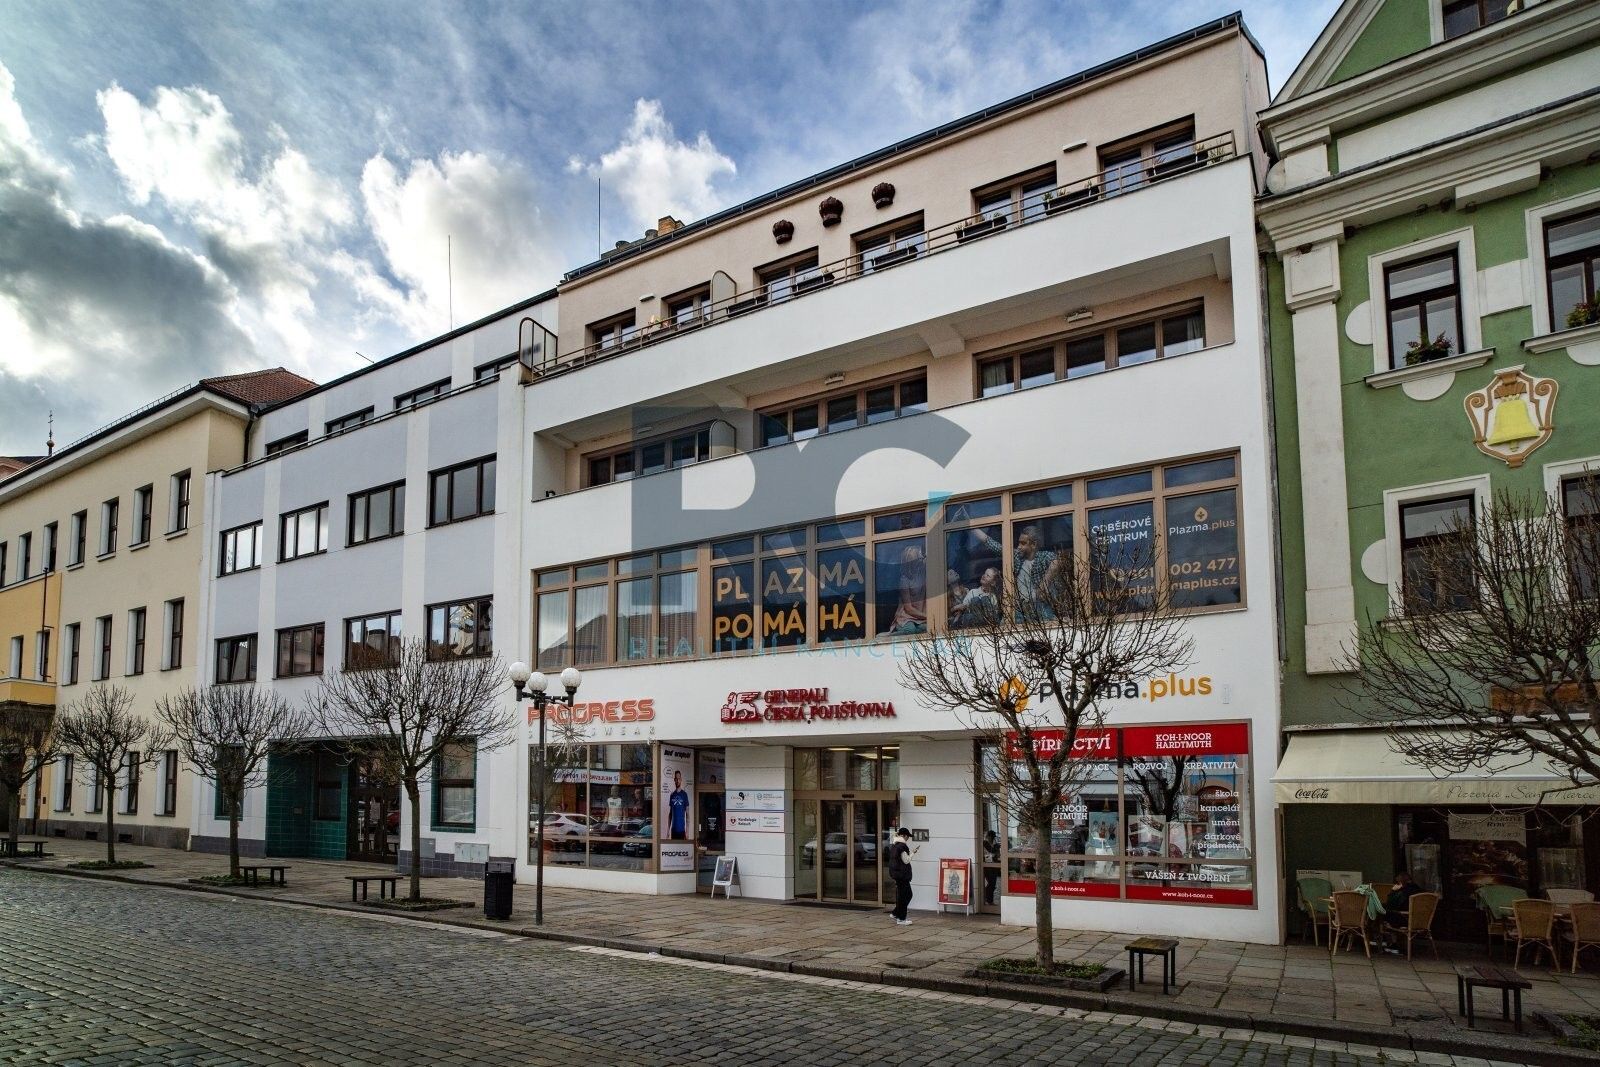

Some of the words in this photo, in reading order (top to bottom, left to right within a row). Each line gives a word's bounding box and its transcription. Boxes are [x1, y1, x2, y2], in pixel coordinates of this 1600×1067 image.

[1169, 518, 1236, 536] Plazma.plus
[1170, 561, 1202, 576] 002
[1206, 557, 1237, 572] 477
[1039, 672, 1213, 703] Pama.plus
[764, 687, 830, 704] GENERALI
[527, 698, 656, 727] PROGRESS
[764, 704, 806, 721] ČESKÁ
[808, 700, 897, 721] POJIŠŤOVNA
[1012, 733, 1111, 752] PÍRCTVÍ
[1155, 732, 1212, 742] KOH-I-NOOR
[1155, 740, 1212, 750] HARDTMUTH
[1132, 762, 1168, 771] ROZVOJ
[1183, 760, 1239, 771] KREATIVITA
[1214, 789, 1240, 798] škola
[1200, 803, 1241, 812] kancelář
[1211, 818, 1241, 826] umění
[1204, 832, 1242, 841] dárkové
[1144, 869, 1177, 881] VÁŠEŇ
[1178, 872, 1185, 881] Z
[1161, 890, 1214, 899] www.koh-i-noor.cz
